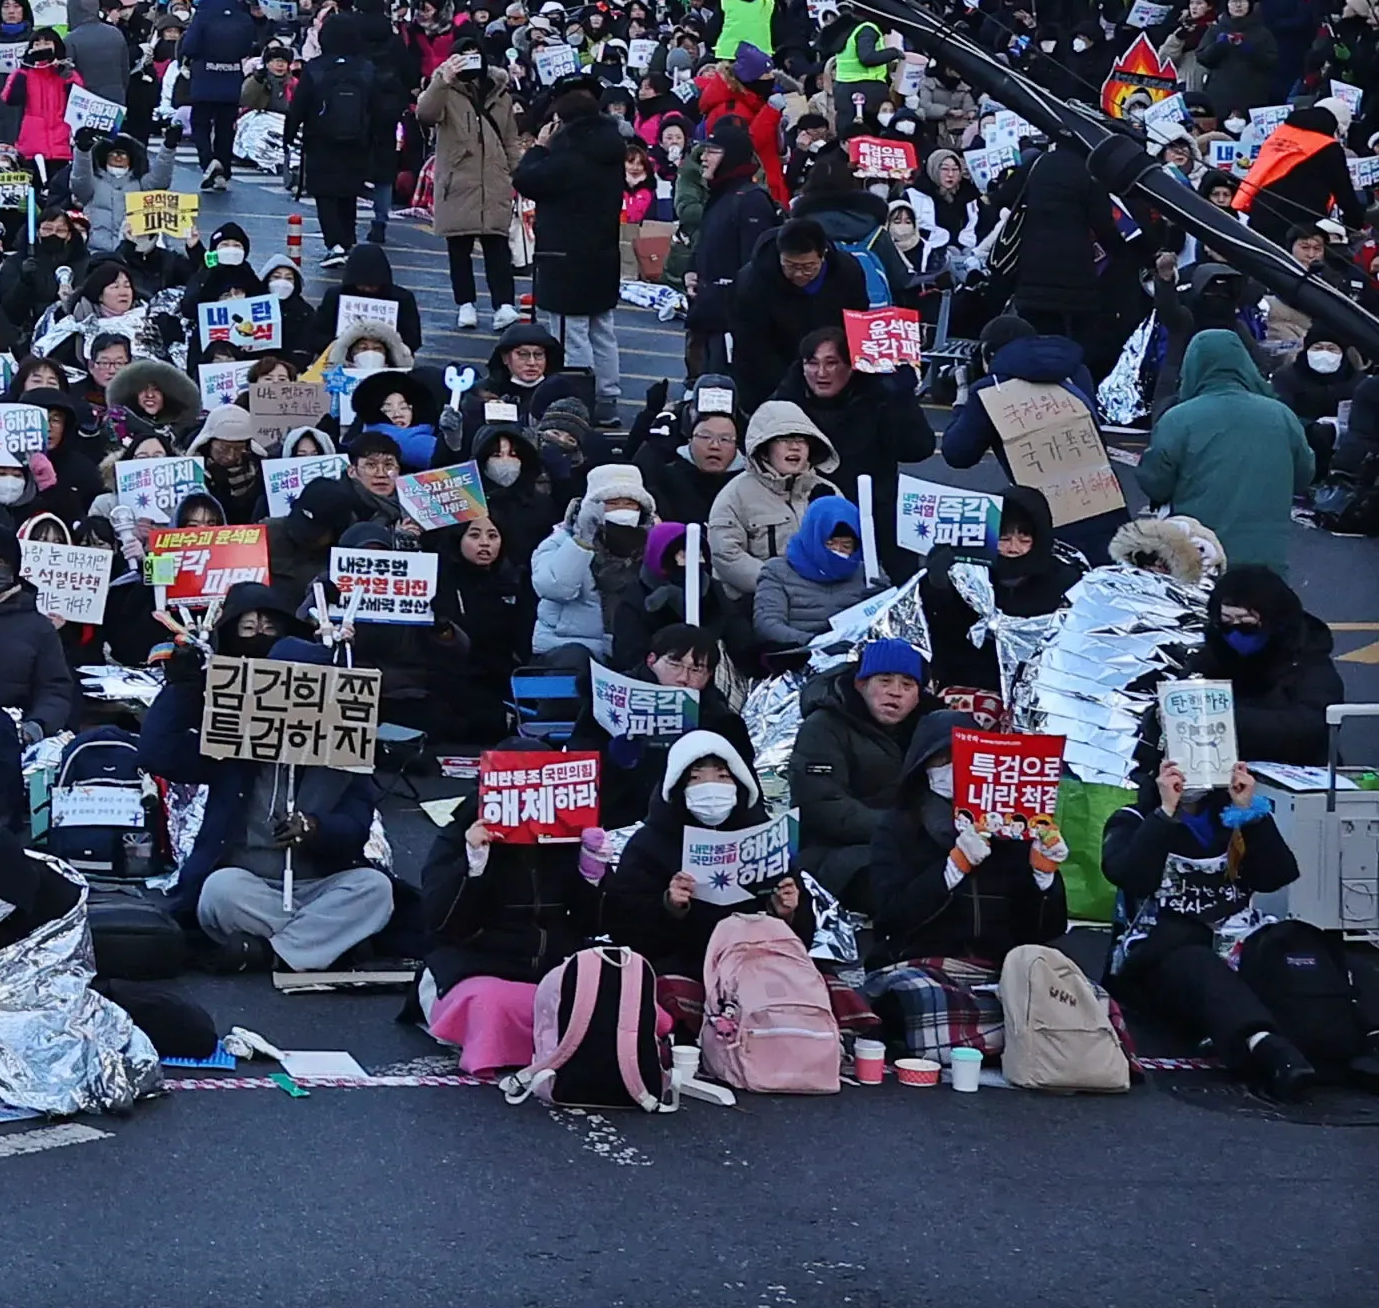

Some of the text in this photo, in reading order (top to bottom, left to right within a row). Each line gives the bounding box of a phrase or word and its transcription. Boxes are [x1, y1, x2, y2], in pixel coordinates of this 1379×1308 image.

[859, 146, 906, 161] 특검으로
[864, 155, 908, 168] 내란 척결
[141, 195, 179, 210] 윤석열
[142, 213, 181, 234] 파면
[868, 320, 920, 341] 윤석열
[861, 340, 898, 358] 즉각
[5, 409, 42, 433] 해체
[5, 431, 44, 454] 하라
[154, 463, 195, 487] 해체
[301, 458, 342, 484] 즉각
[269, 477, 299, 494] 윤석열
[938, 497, 990, 521] 즉각
[155, 529, 261, 549] 내란수괴 윤석열
[933, 521, 987, 547] 파면
[50, 547, 109, 574] 눈 마주치면
[337, 555, 408, 575] 내란주범
[336, 575, 428, 597] 윤석열 퇴진
[398, 599, 430, 615] 청산
[209, 662, 328, 714] 김건희
[629, 688, 685, 712] 즉각
[627, 712, 684, 739] 파면
[483, 761, 595, 789] 내란동조 국민의힘
[968, 753, 1061, 779] 특검으로
[483, 781, 598, 826] 해체하라
[967, 783, 1058, 814] 내란 척결
[688, 839, 737, 857] 내란동조
[739, 818, 791, 862] 해체
[688, 851, 738, 868] 국민의힘
[737, 850, 793, 888] 하라
